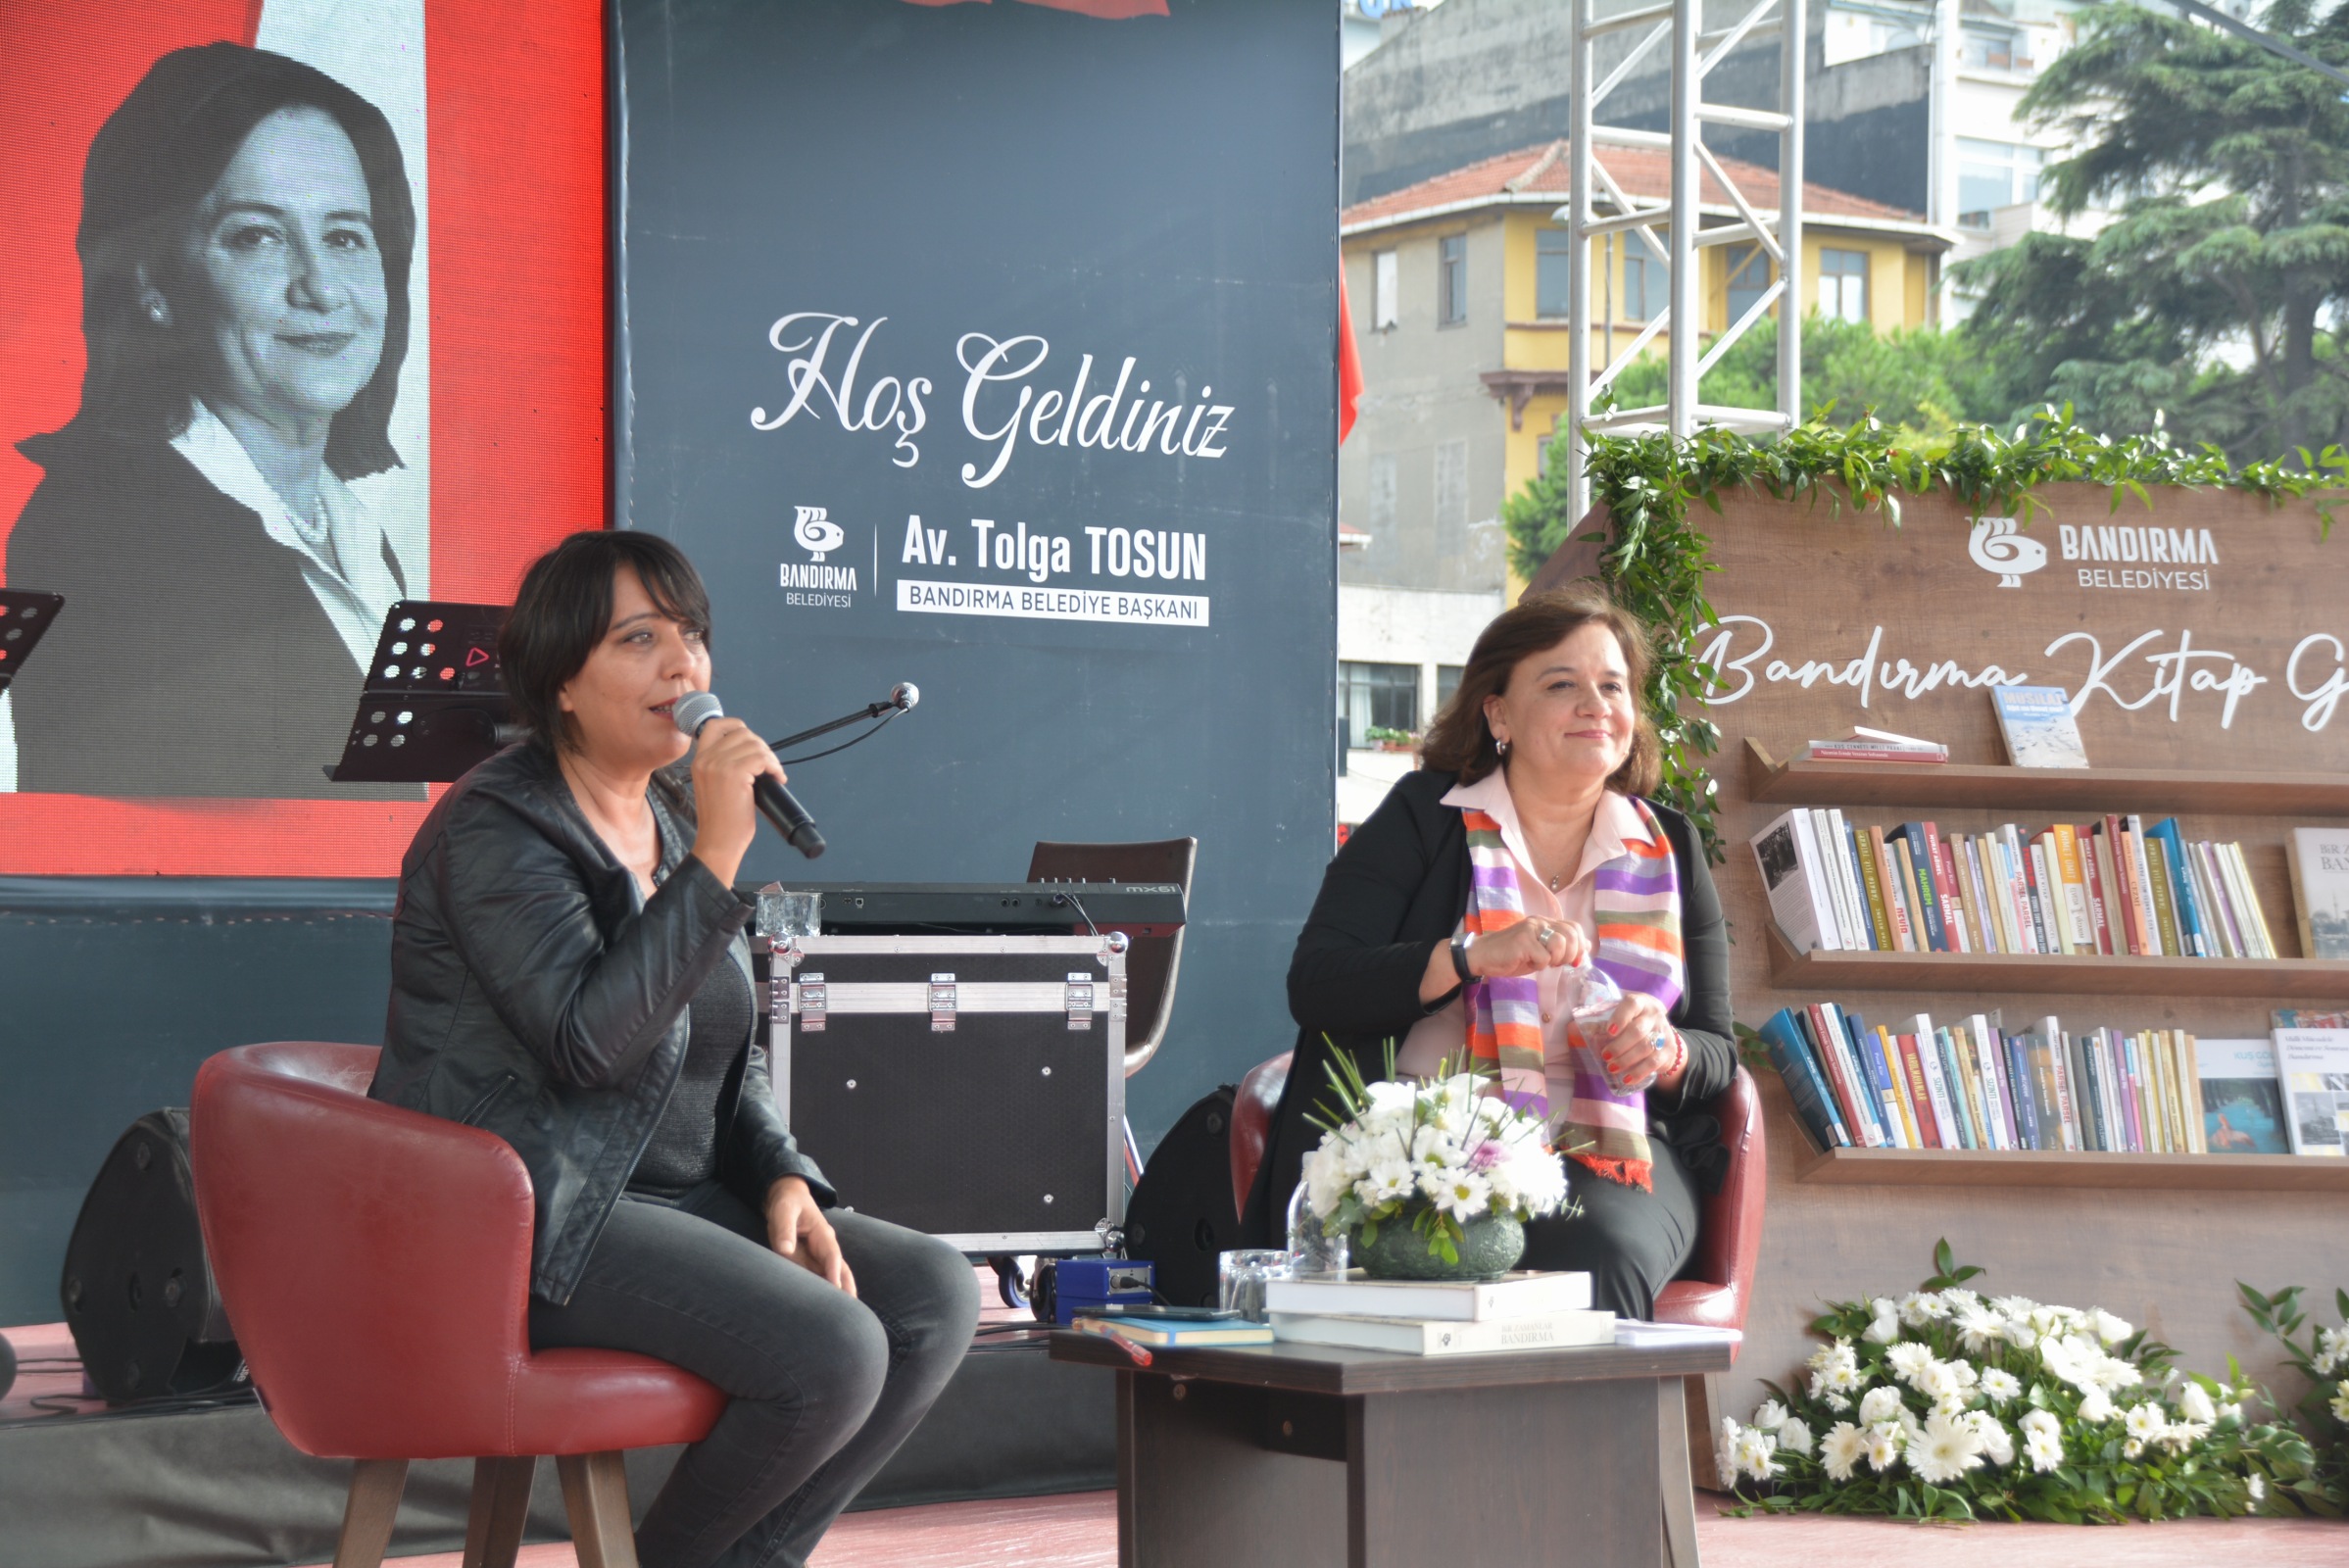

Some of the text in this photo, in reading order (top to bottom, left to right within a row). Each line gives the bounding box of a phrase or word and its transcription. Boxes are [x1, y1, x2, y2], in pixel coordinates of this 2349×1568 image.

[751, 312, 1235, 489] Hoş Geldiniz
[902, 514, 1206, 583] Av. Tolga TOSUN
[2059, 524, 2219, 564] BANDIRMA
[780, 563, 856, 592] BANDIRMA
[2078, 567, 2210, 591] BELEDİYESİ
[786, 592, 851, 609] BELEDİYESİ
[909, 585, 1199, 621] BANDIRMA BELEDİYE BAŞKANI
[1680, 615, 2028, 708] Bandırma
[1928, 833, 1937, 854] MURAT
[2059, 829, 2073, 857] AHMET
[1917, 867, 1933, 906] MAHREM
[2014, 870, 2032, 929] PARSEL PARSEL
[1939, 893, 1953, 925] SARMAL
[2091, 896, 2105, 929] SARMAL
[1904, 1052, 1927, 1102] VAROLMAYANLAR
[2055, 1064, 2072, 1124] PARSEL PARSEL
[1501, 1332, 1554, 1346] BANDIRMA
